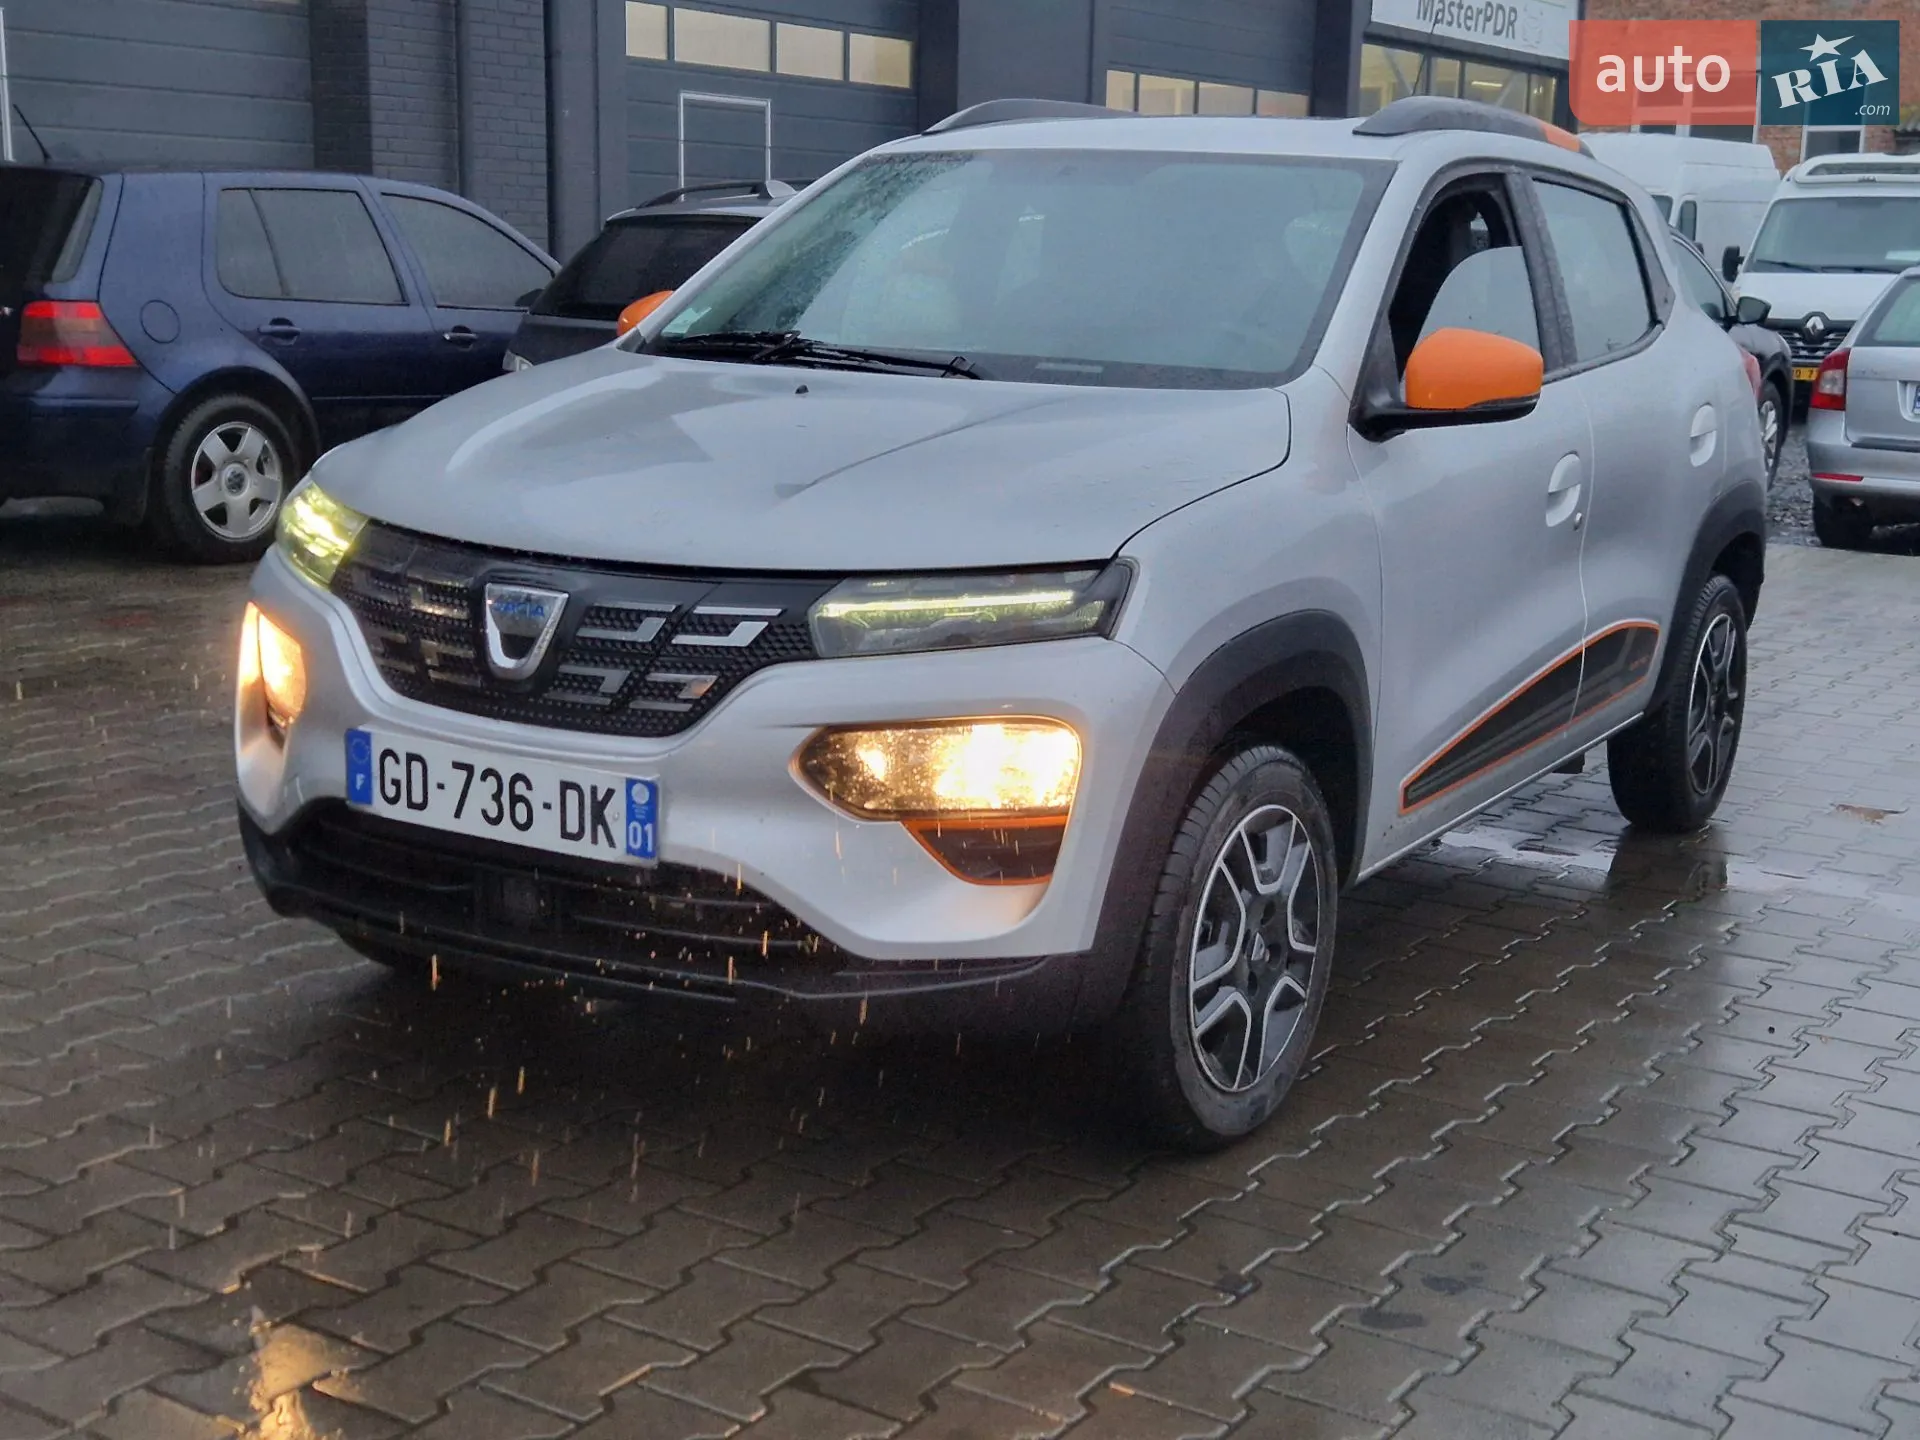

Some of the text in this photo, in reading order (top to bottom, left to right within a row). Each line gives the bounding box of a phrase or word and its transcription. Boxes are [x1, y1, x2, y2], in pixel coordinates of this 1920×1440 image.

[1416, 0, 1518, 40] MasterPDR
[378, 748, 617, 849] GD-736-DK
[628, 821, 653, 853] 01
